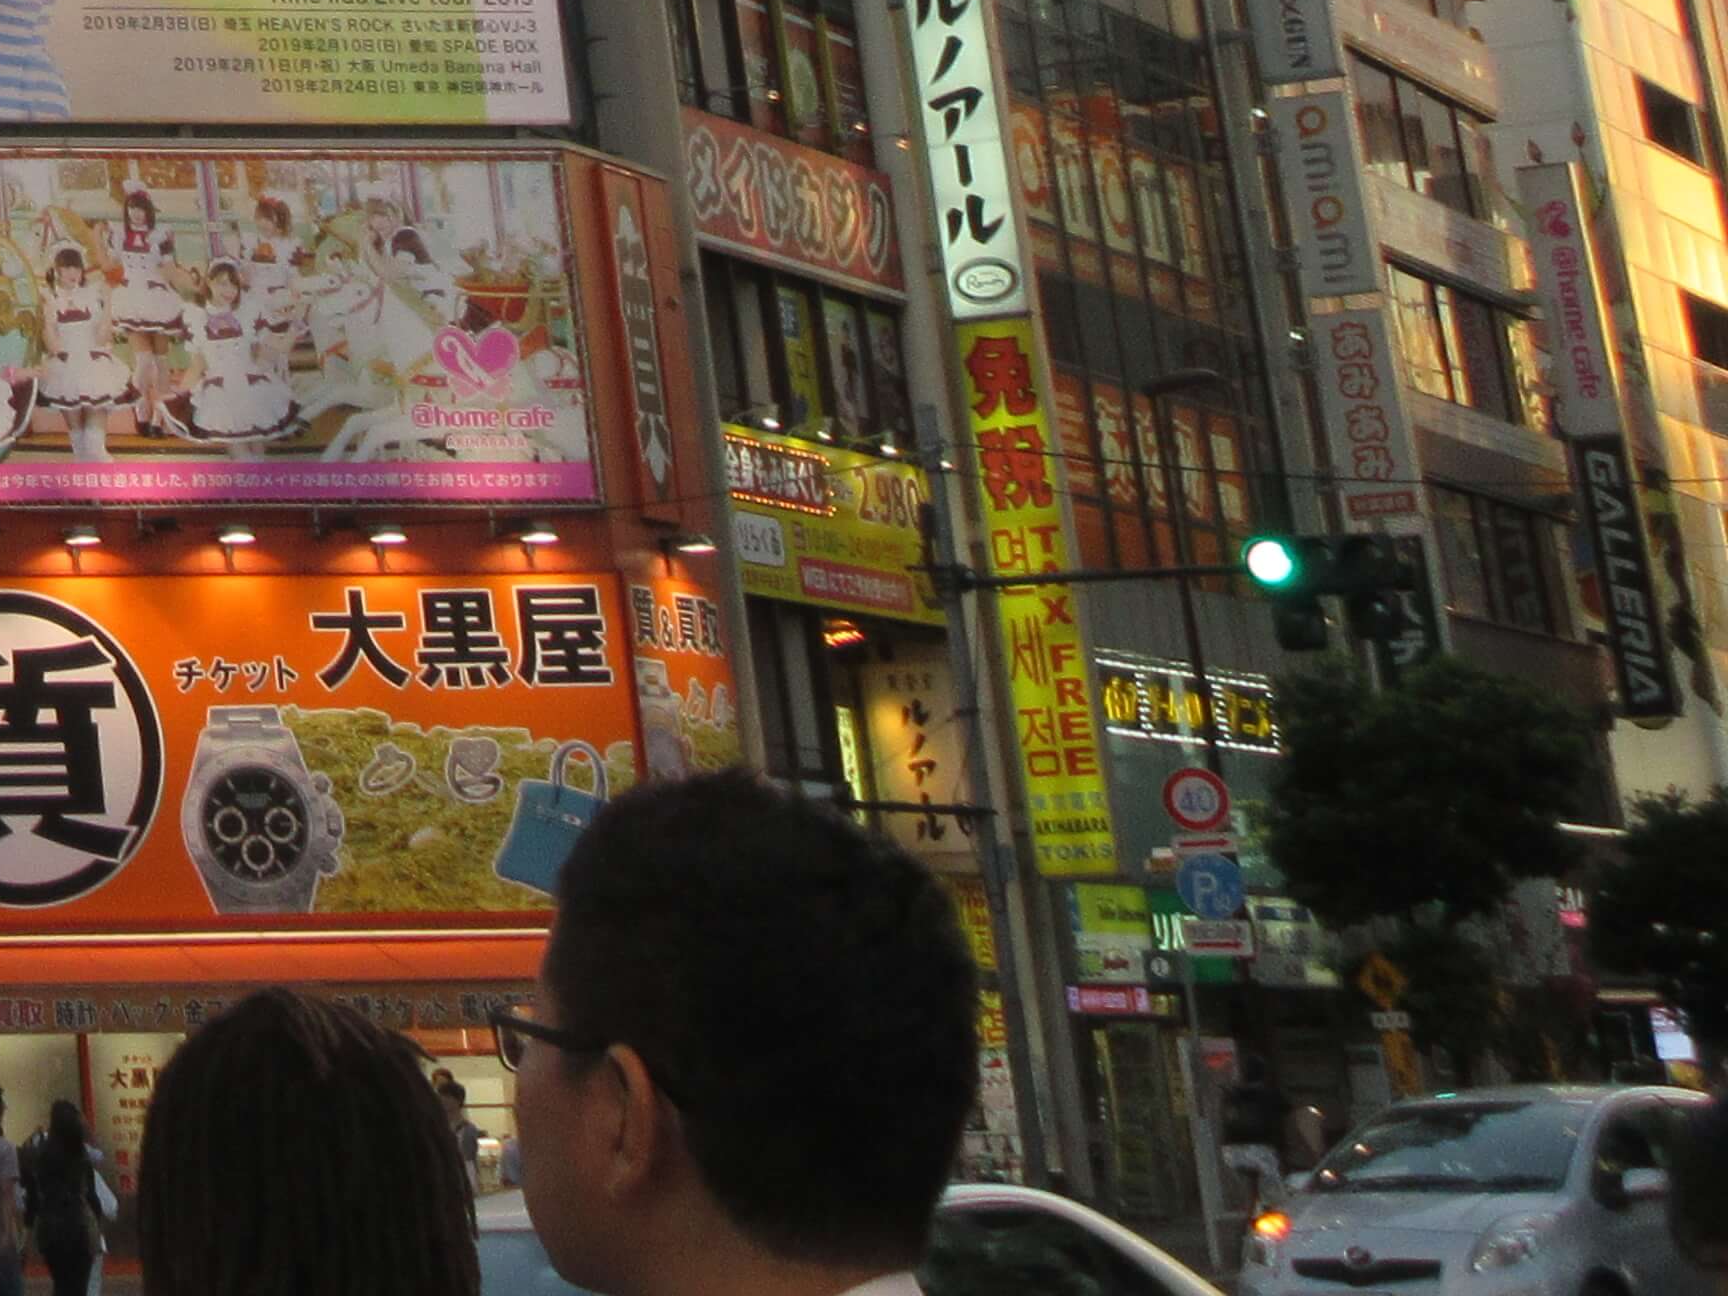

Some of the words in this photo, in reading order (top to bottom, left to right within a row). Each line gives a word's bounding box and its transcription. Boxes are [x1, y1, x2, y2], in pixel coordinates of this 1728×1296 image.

[82, 15, 218, 34] 2019年2月3日(日)
[347, 15, 395, 33] ROCK
[258, 38, 402, 56] 2019年2月10日(日)
[442, 38, 499, 56] SPADE
[503, 38, 539, 55] BOX
[381, 58, 441, 76] Umeda
[444, 59, 506, 76] Banana
[510, 59, 542, 76] Hall
[260, 79, 407, 97] 2019年2月24日(日)
[1294, 105, 1356, 285] amiami
[410, 404, 500, 428] @home
[505, 405, 556, 428] cafe
[965, 335, 1053, 509] 免税
[1028, 525, 1073, 625] TAX
[1582, 449, 1664, 708] GALLERIA
[173, 658, 299, 694] チケット
[310, 585, 616, 691] 大黒屋
[1048, 643, 1100, 778] FREE
[1177, 784, 1215, 812] 40
[1192, 873, 1218, 913] P
[108, 1066, 154, 1090] 大黒
